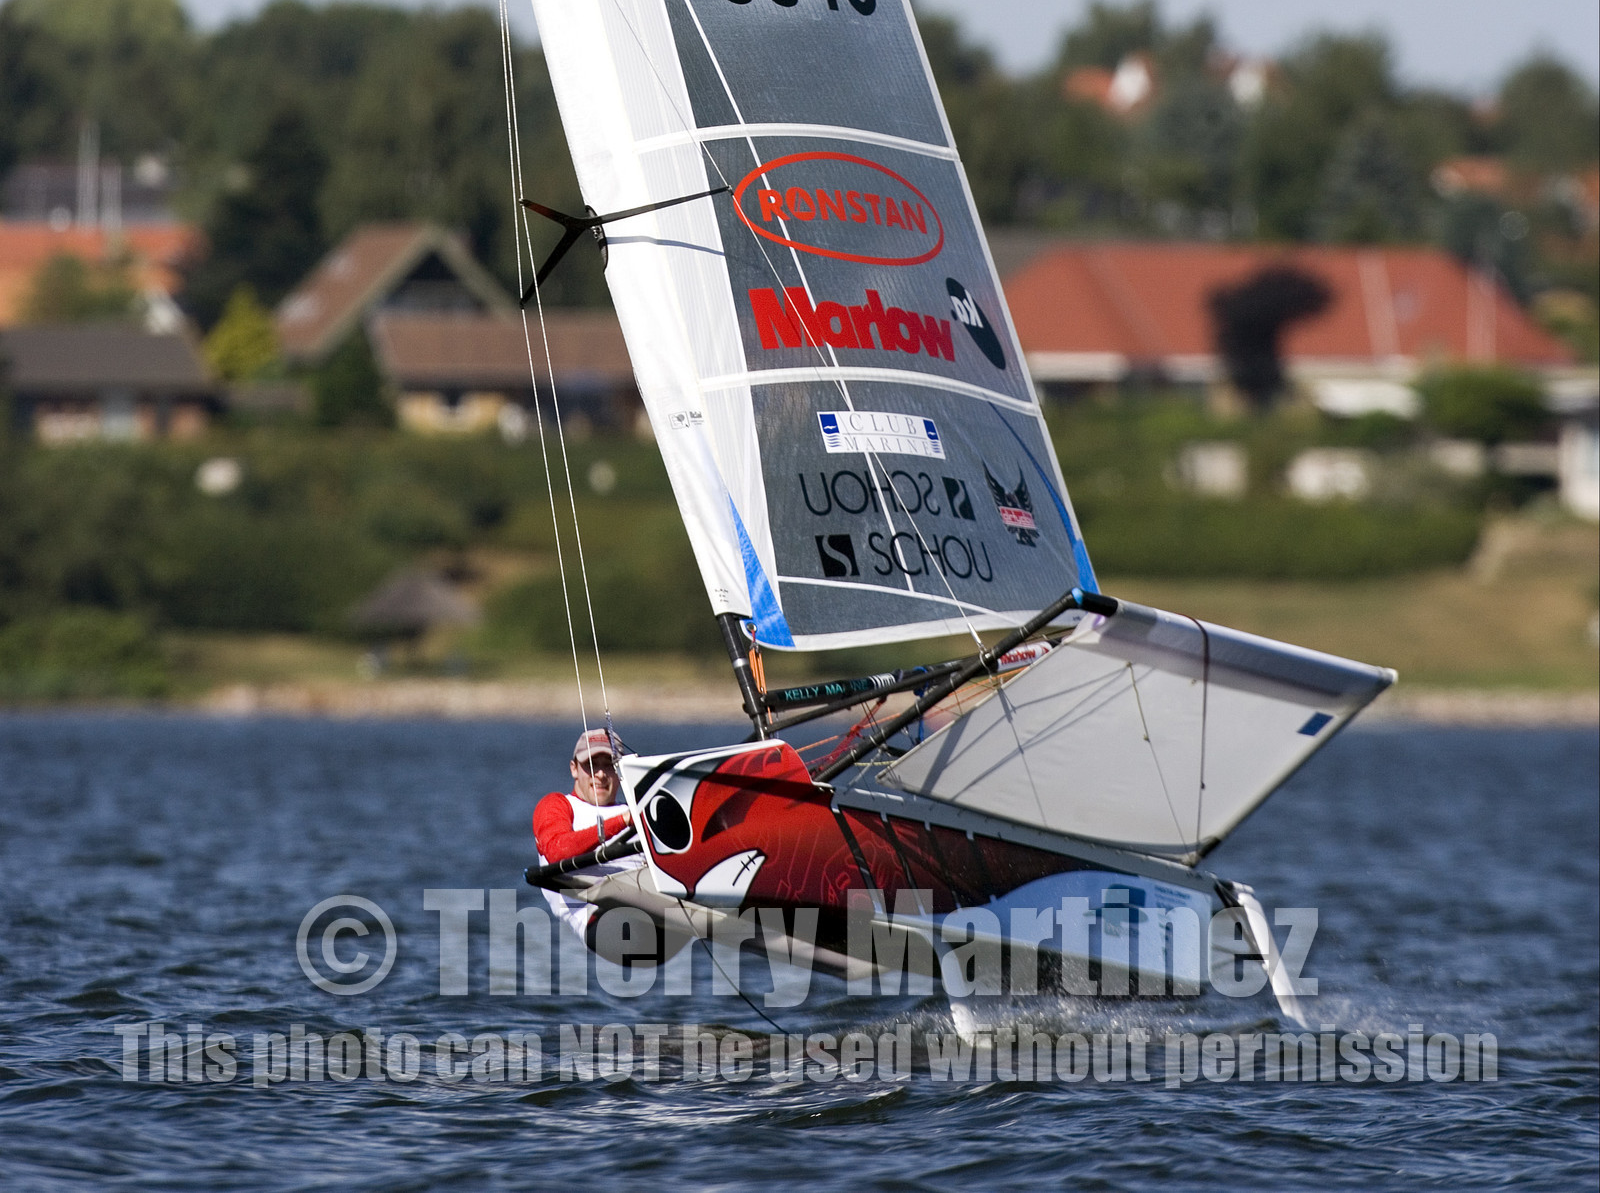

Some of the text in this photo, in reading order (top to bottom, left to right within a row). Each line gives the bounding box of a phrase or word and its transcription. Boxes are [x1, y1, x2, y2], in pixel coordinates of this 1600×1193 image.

[758, 186, 928, 235] RONSTAN
[748, 286, 956, 362] Marlow
[849, 413, 917, 435] CLUB
[844, 436, 932, 456] MARINE
[868, 531, 993, 582] SCHOU
[785, 678, 869, 701] KELLY MAINE
